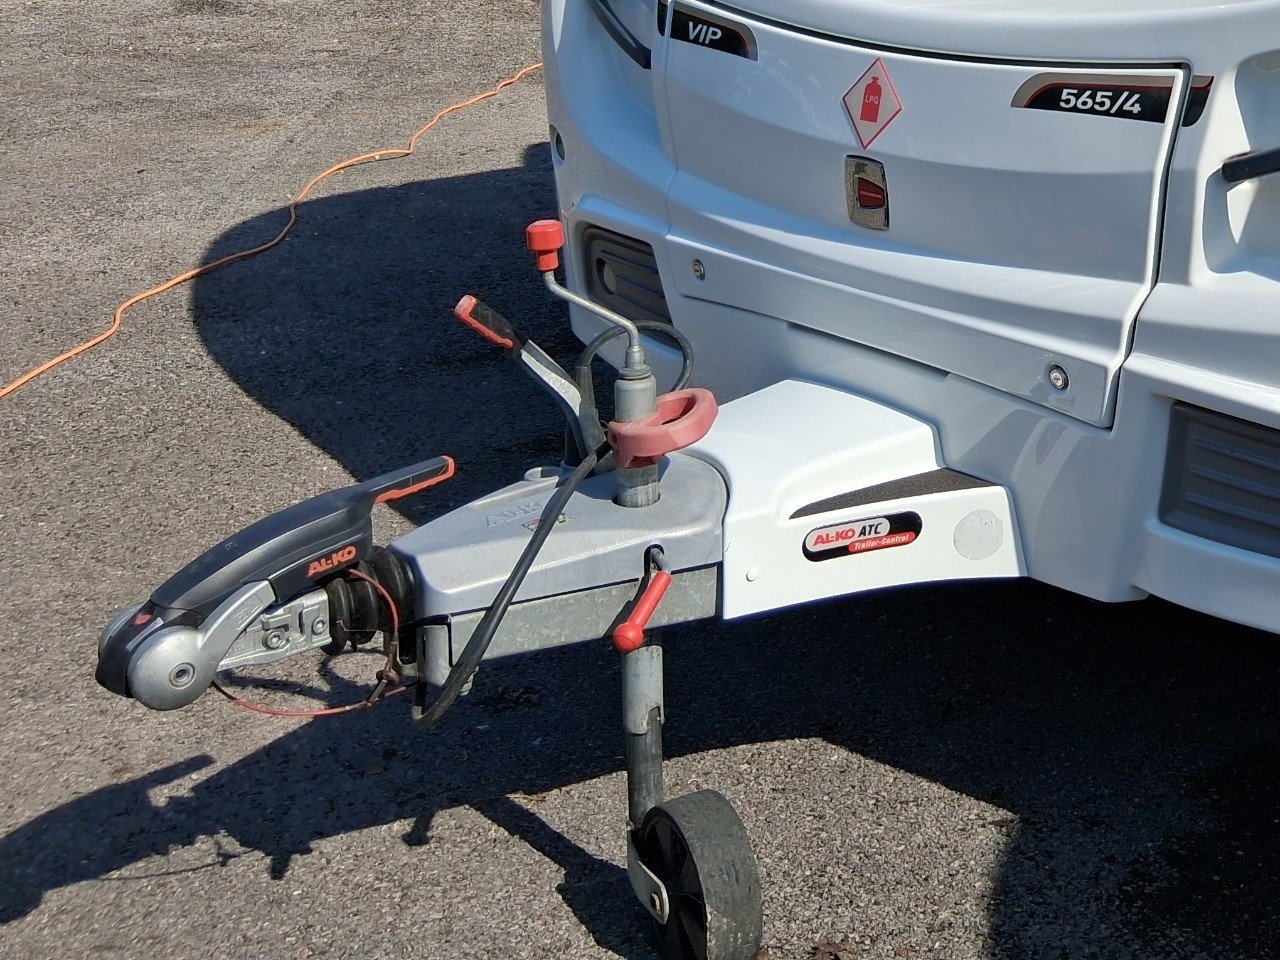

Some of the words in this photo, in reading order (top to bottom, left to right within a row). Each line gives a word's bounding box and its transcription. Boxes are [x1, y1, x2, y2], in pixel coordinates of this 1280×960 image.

[688, 21, 722, 45] VIP
[865, 95, 879, 104] LPG
[1059, 88, 1141, 114] 565/4
[813, 528, 856, 546] AL-KO
[858, 523, 882, 537] ATC
[307, 545, 357, 577] AL-KO
